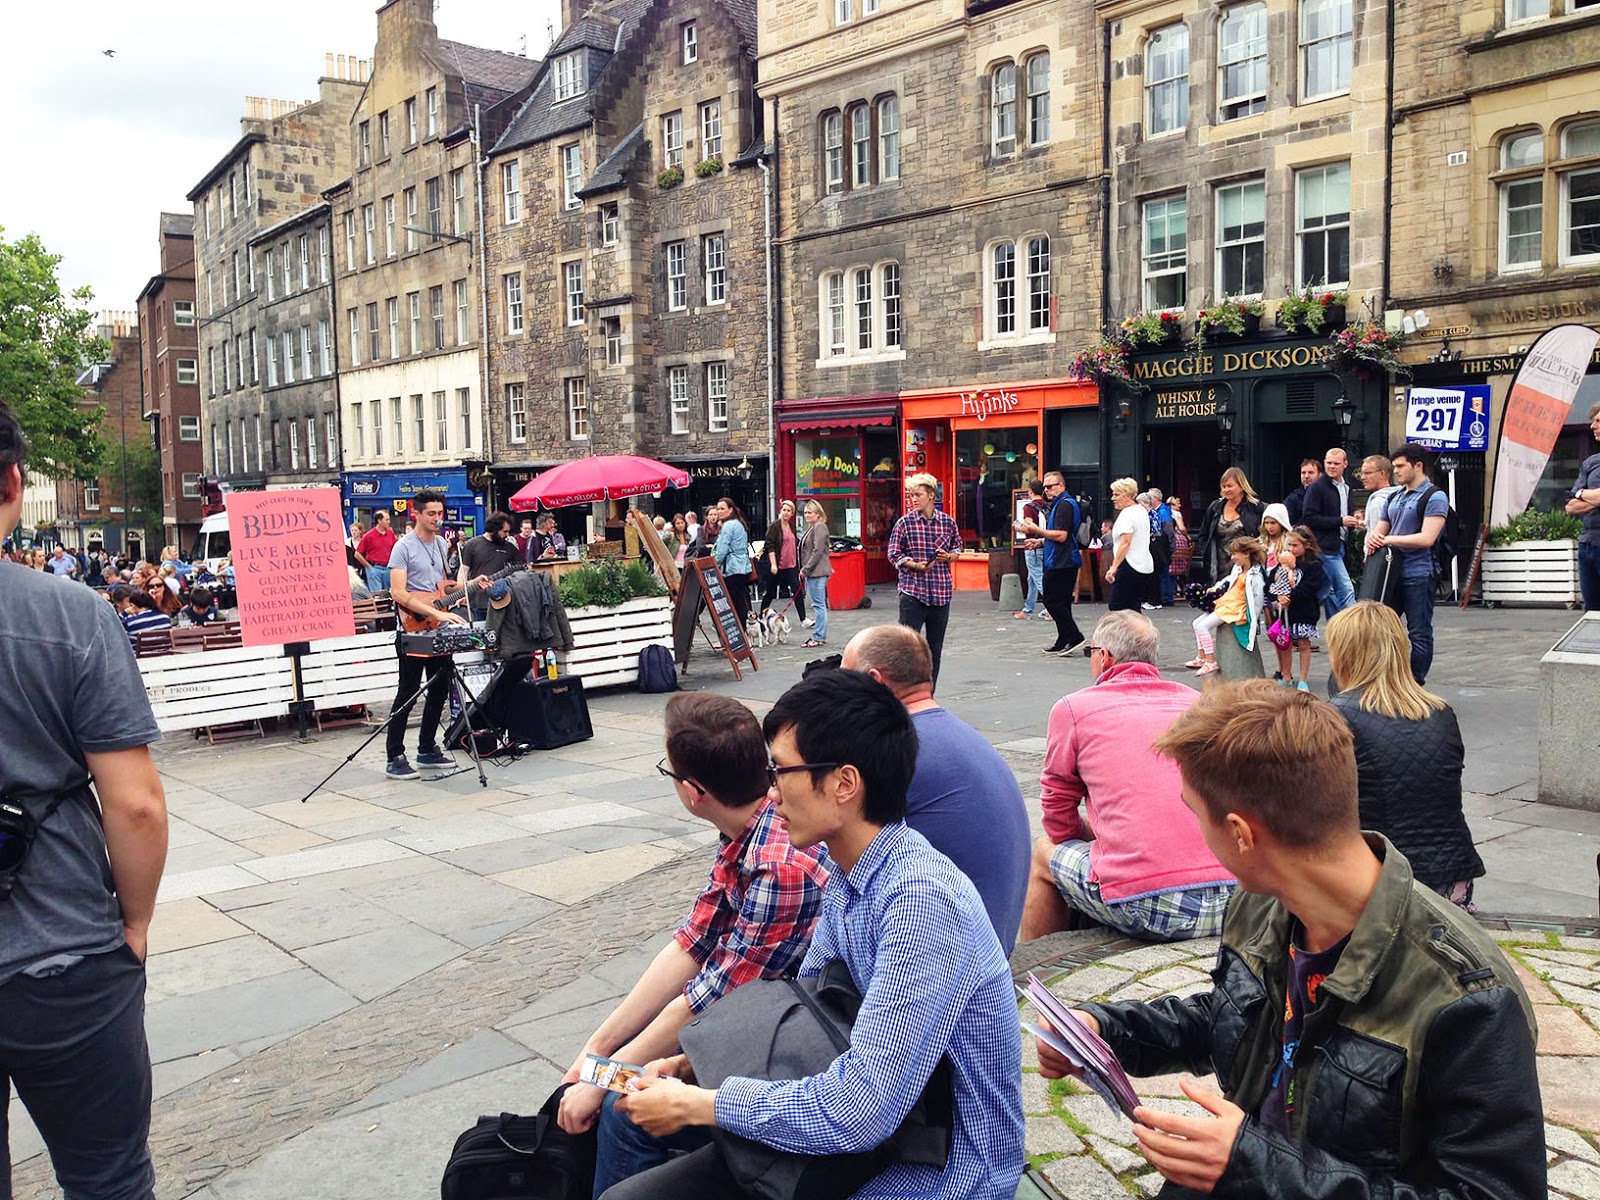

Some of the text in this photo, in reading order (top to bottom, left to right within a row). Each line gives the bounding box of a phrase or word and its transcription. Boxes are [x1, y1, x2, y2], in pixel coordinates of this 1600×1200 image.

[1503, 301, 1586, 324] MISSION
[1132, 354, 1214, 380] MAGGIE
[1462, 356, 1524, 374] THE SMA
[1557, 362, 1582, 386] PUB
[1156, 388, 1216, 405] WHISKY &
[1411, 395, 1461, 406] fringe venue
[960, 389, 1018, 422] Hijinks
[1155, 402, 1216, 418] ALE HOUSE
[1415, 408, 1457, 431] 297
[691, 467, 713, 477] LAST
[797, 455, 859, 478] Scooby Doo's
[514, 473, 529, 481] THE
[353, 482, 373, 494] Premier
[242, 510, 331, 539] BIDDY'S
[239, 541, 339, 561] LIVE MUSIC
[247, 555, 334, 573] & NIGHTS
[259, 573, 315, 586] GUINNESS
[261, 582, 327, 596] CRAFT ALES
[243, 593, 347, 612] HOMEMADE MEALS
[244, 605, 350, 626] FAIRTRADE COFFEE
[262, 620, 336, 637] GREAT CRAIC
[170, 686, 212, 694] PRODUCE
[552, 686, 569, 694] Roland
[3, 805, 23, 816] Canon
